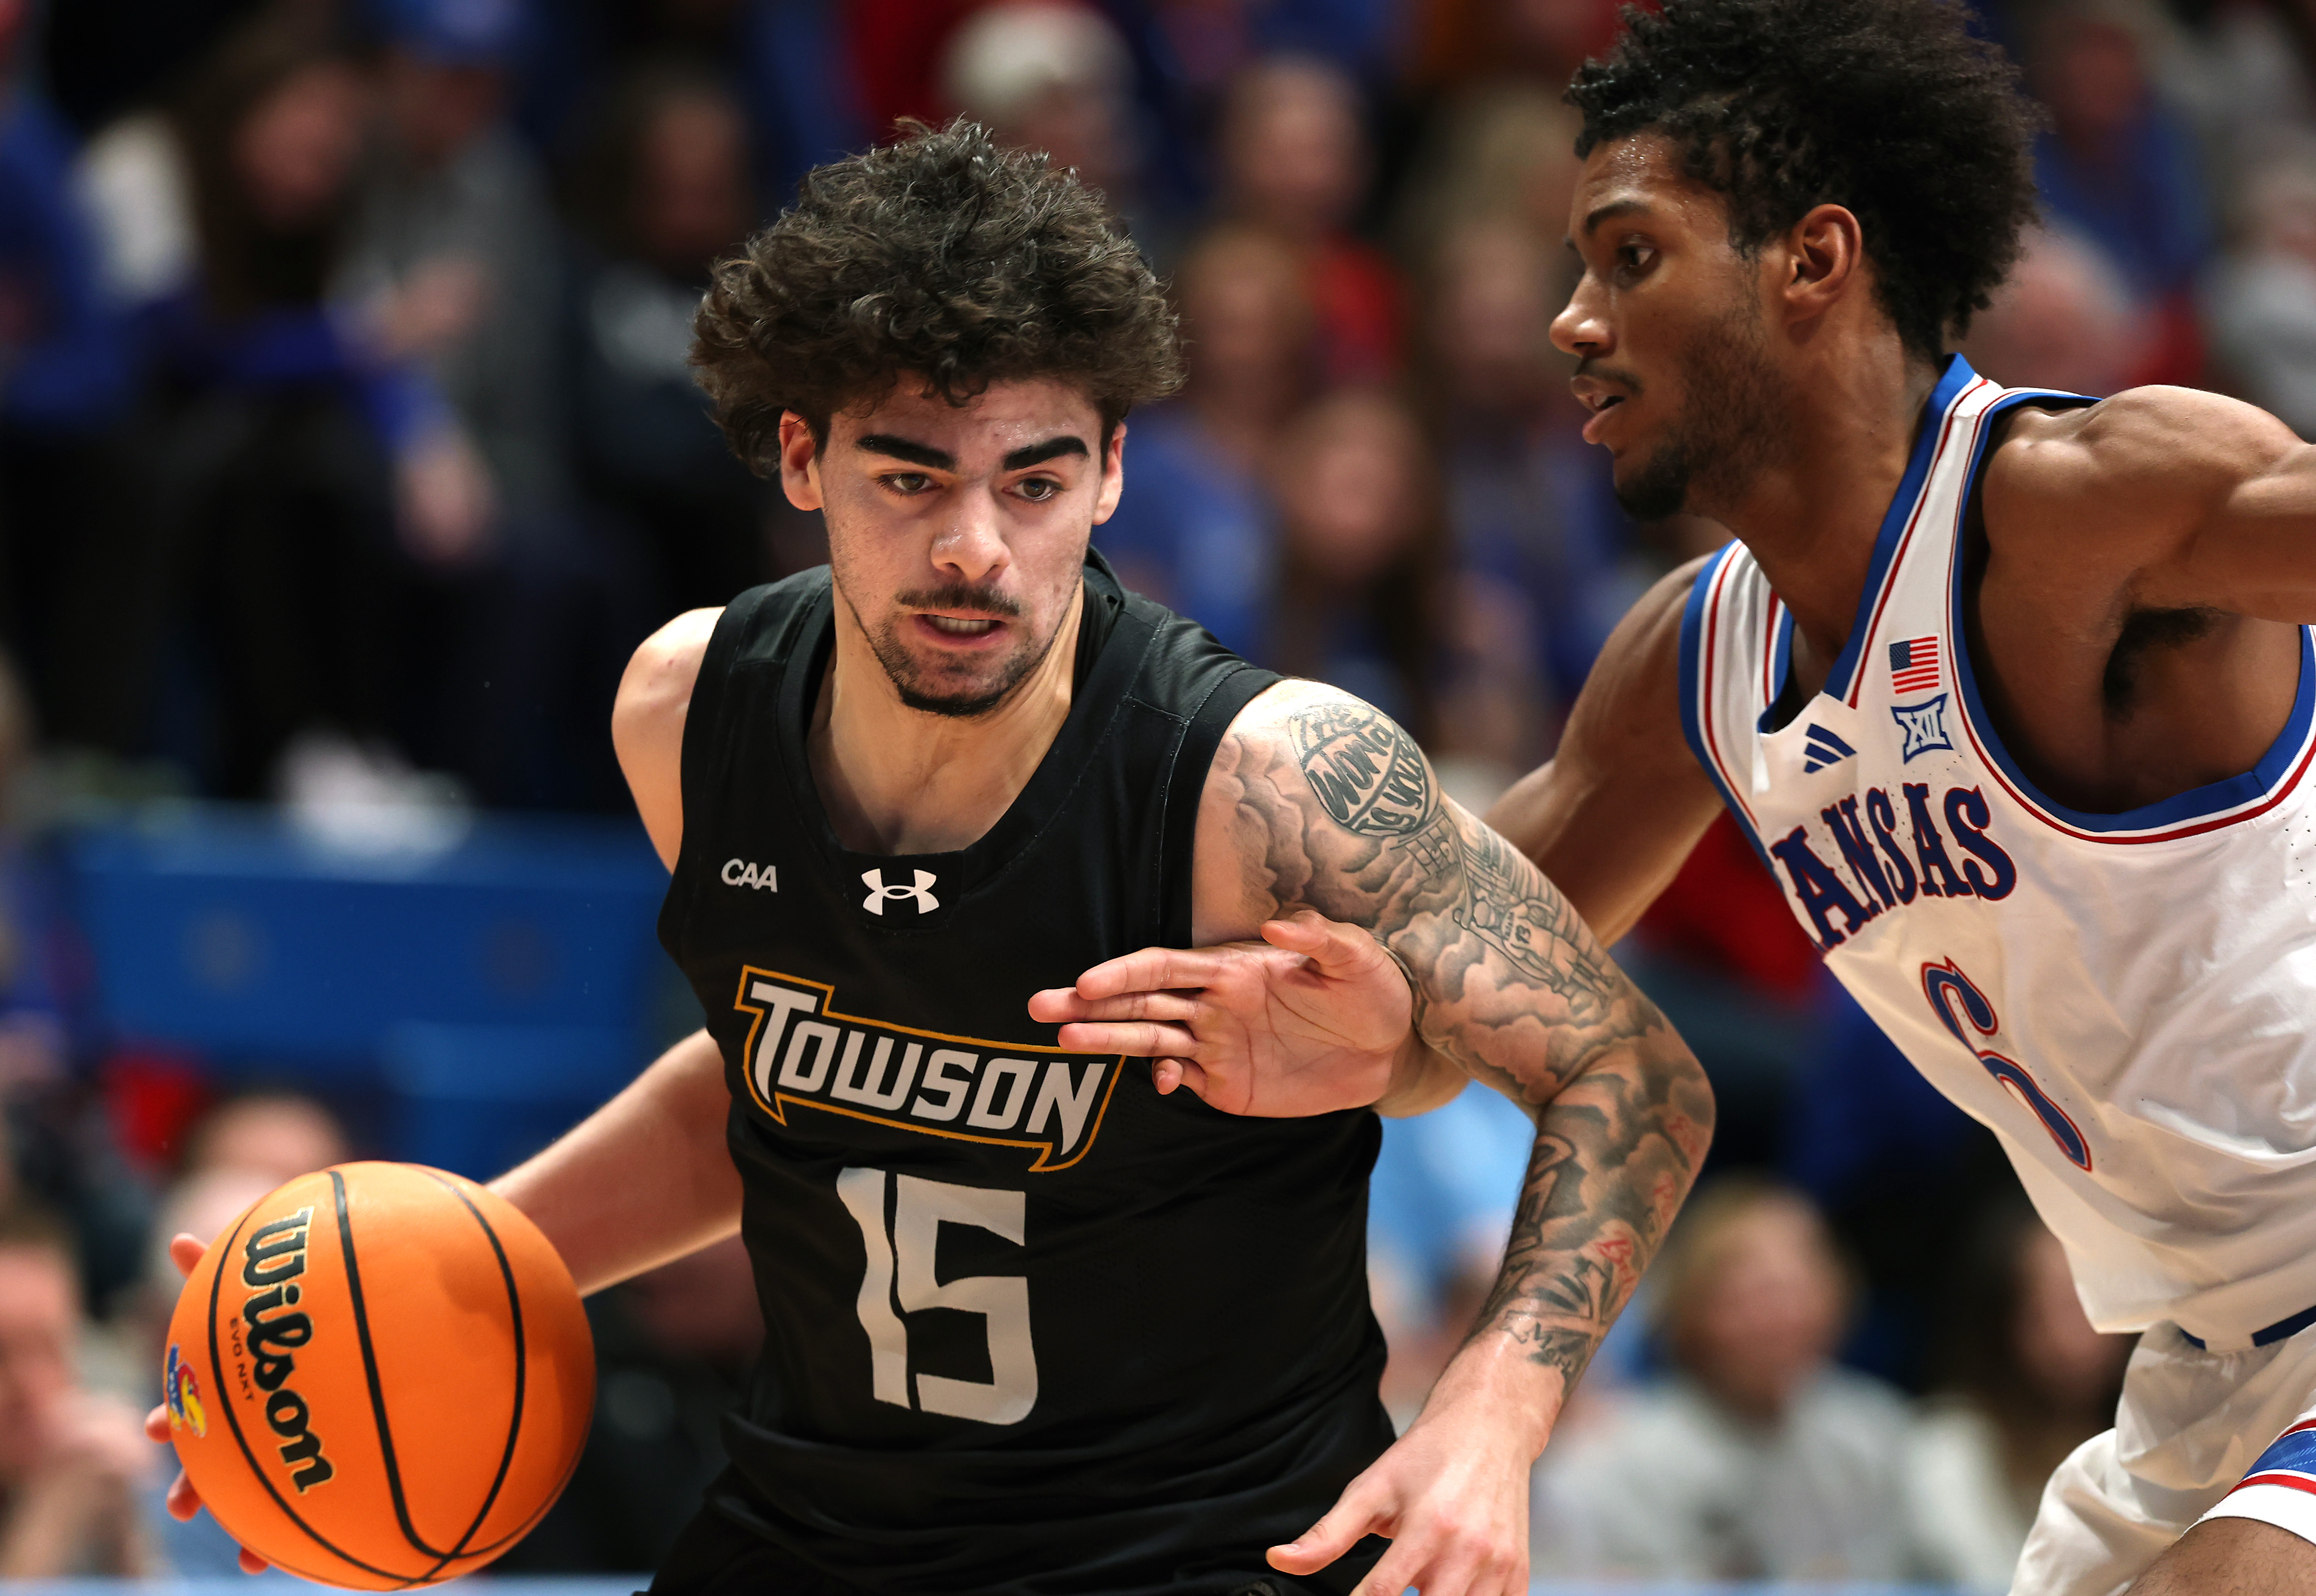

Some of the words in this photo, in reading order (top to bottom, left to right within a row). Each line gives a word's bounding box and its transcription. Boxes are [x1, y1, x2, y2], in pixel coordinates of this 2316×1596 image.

[721, 858, 778, 893] CAA
[1769, 782, 2017, 951] ANSAS
[1921, 955, 2093, 1172] 6
[229, 1317, 242, 1357] EVO
[237, 1363, 254, 1401] NXT
[241, 1205, 337, 1496] Wilson
[836, 1166, 1039, 1426] 15
